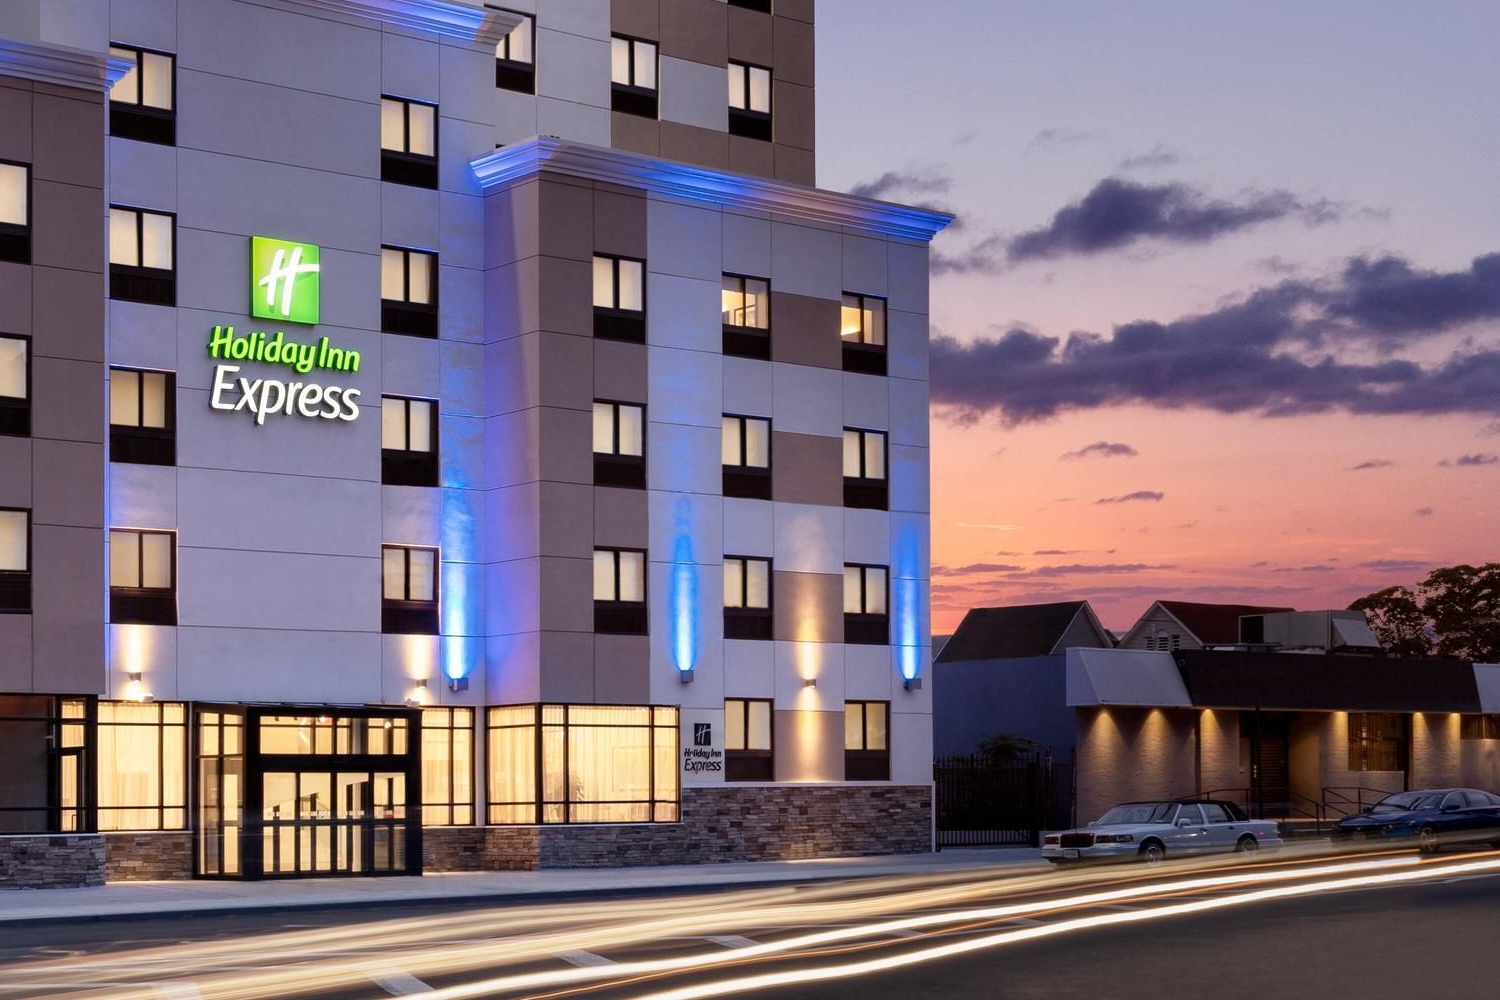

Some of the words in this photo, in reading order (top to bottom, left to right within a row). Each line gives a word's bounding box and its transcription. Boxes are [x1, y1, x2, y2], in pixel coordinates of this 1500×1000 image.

[207, 325, 316, 373] Holiday
[318, 336, 360, 372] Inn
[210, 364, 362, 425] Express
[684, 748, 710, 759] Holiday
[711, 748, 721, 757] Inn
[684, 758, 722, 775] Express
